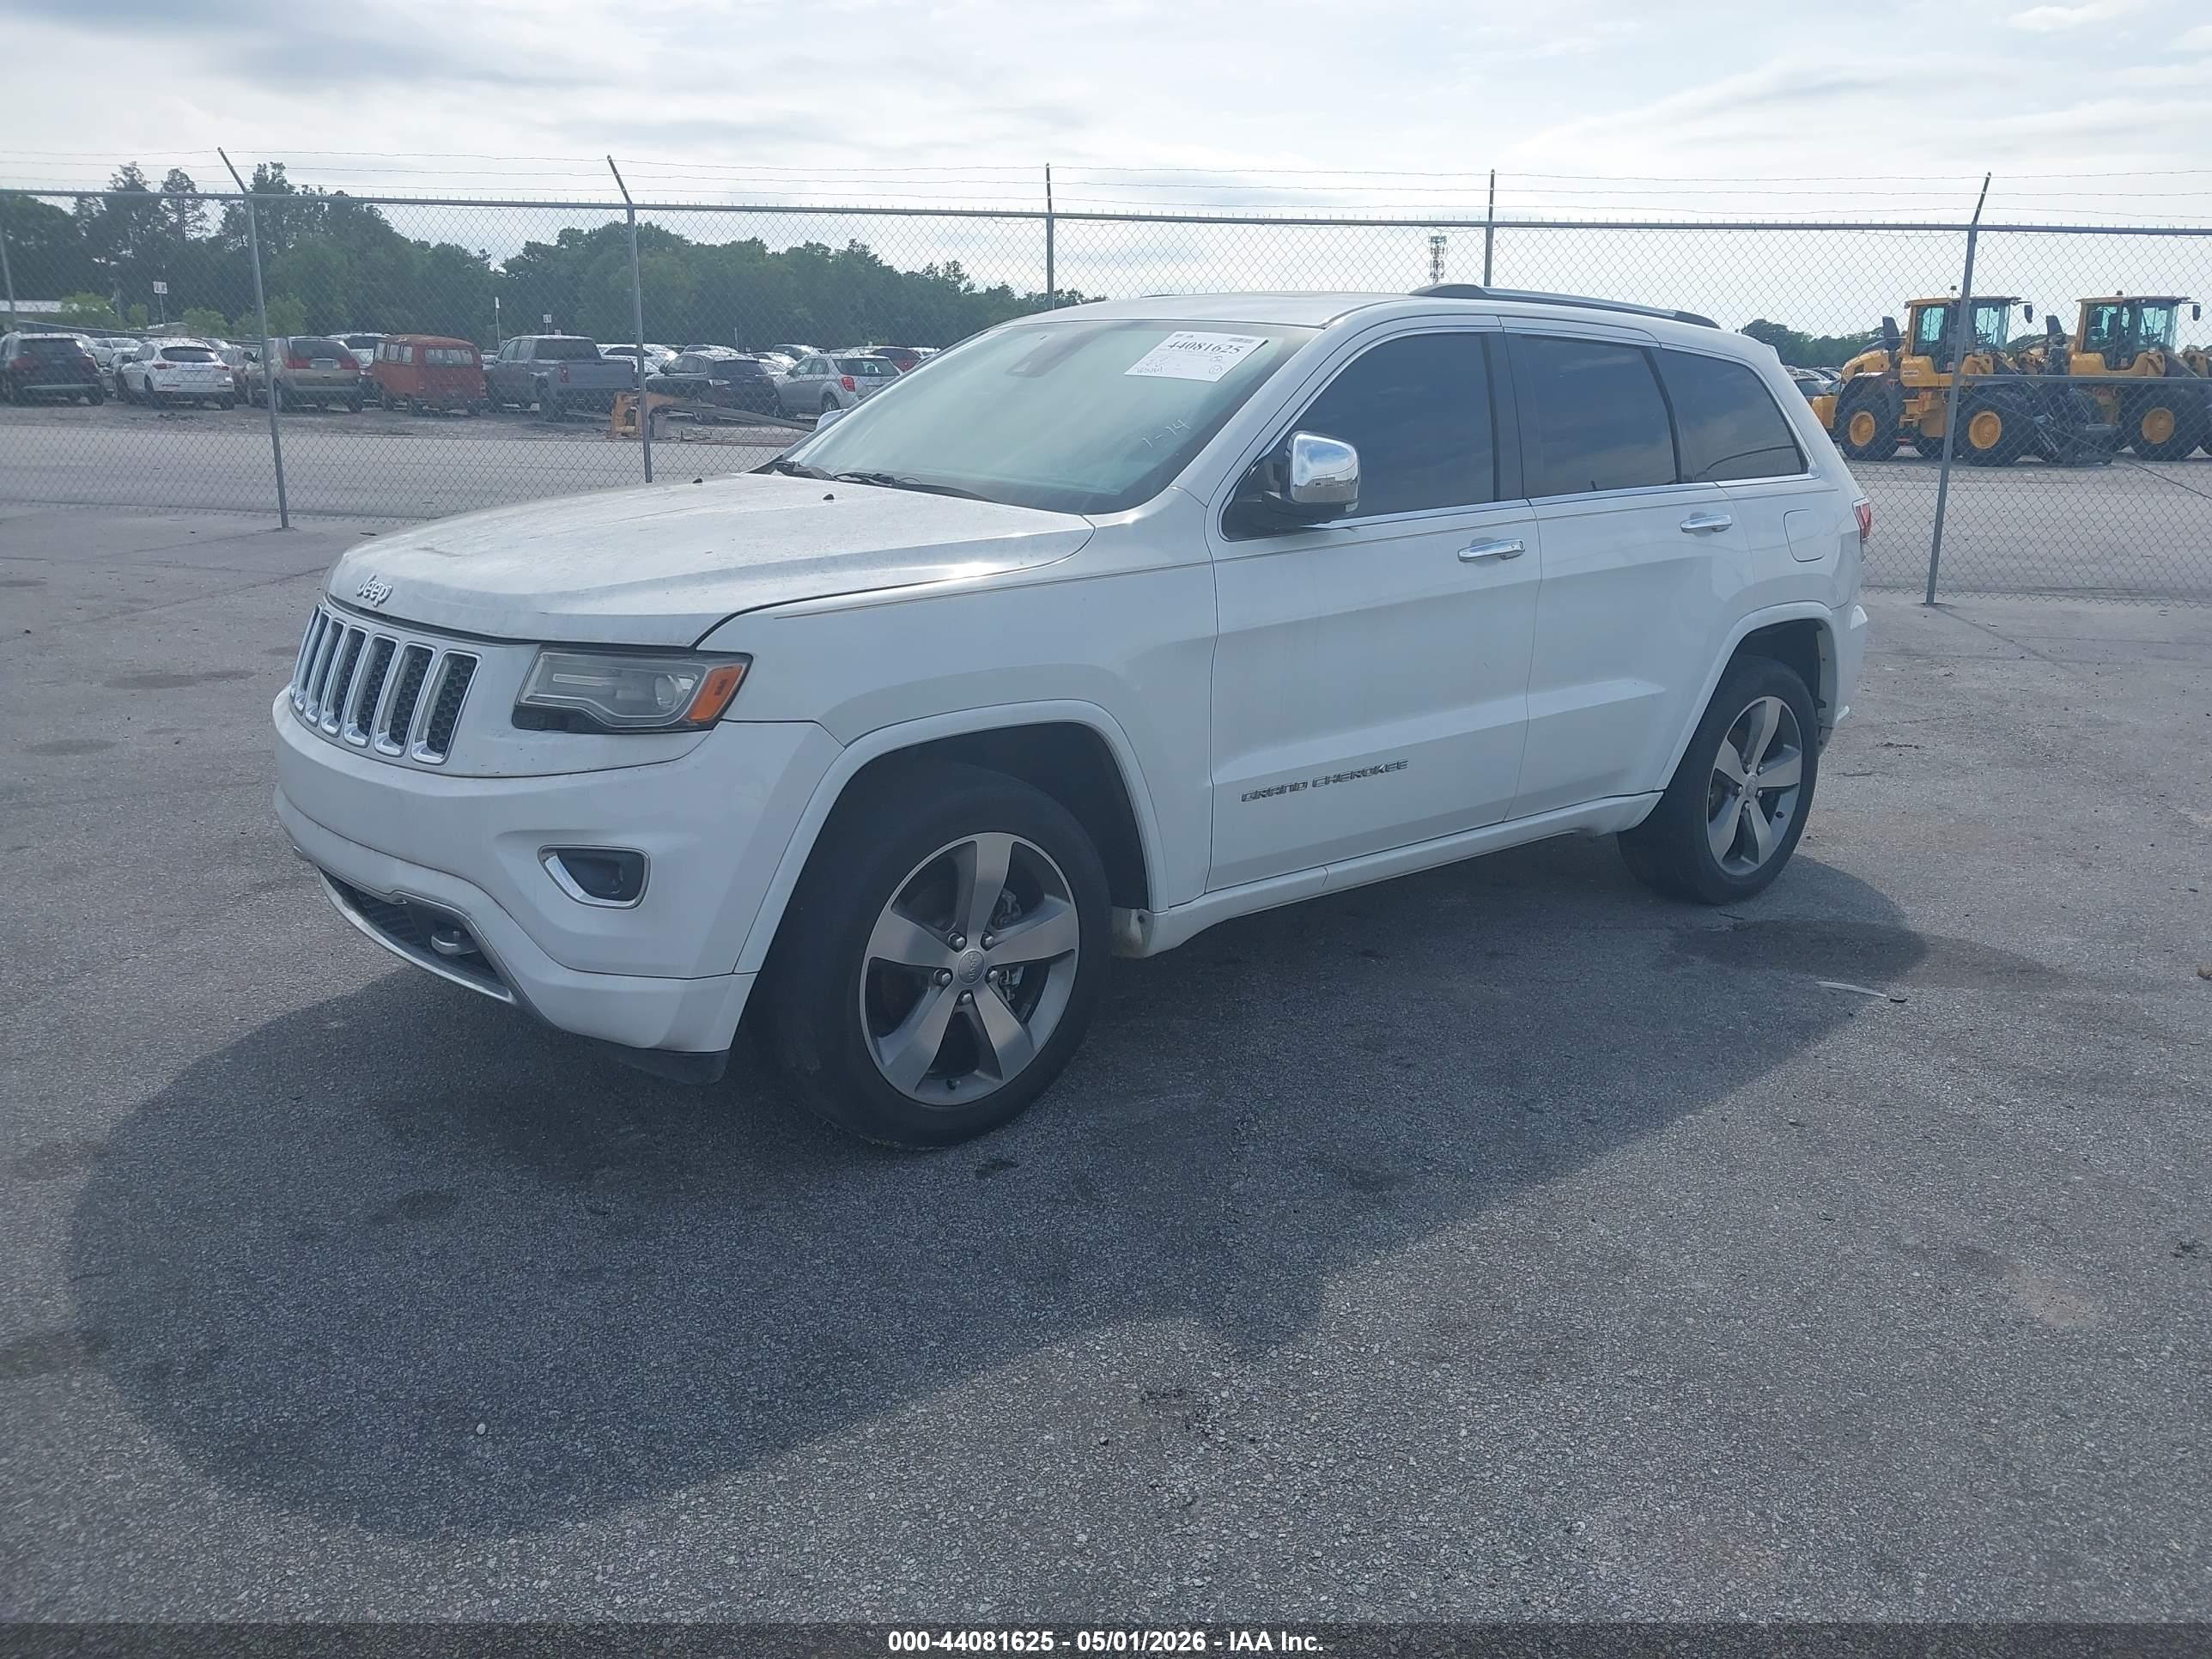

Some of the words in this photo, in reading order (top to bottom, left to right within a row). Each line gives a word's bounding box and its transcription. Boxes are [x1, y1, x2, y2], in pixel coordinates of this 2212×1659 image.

[1167, 340, 1244, 355] 44081625
[356, 573, 393, 608] Jeep
[1241, 781, 1308, 802] GRAND
[1312, 760, 1409, 787] CHEROKEE
